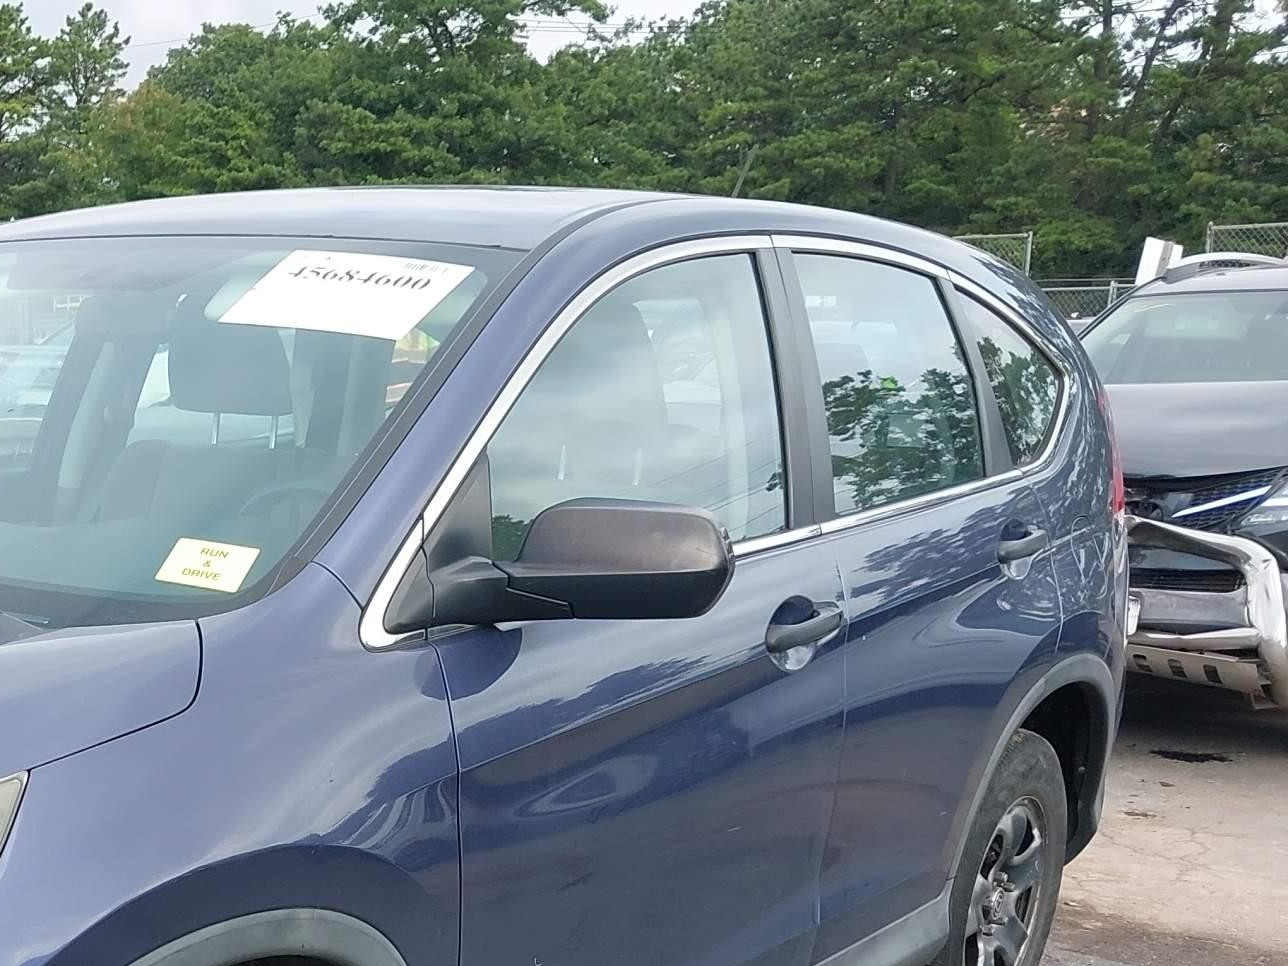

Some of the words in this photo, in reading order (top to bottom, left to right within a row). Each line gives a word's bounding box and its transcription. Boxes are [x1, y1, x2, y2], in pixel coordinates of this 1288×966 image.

[289, 266, 431, 289] 45684600
[200, 548, 229, 558] RUN
[181, 568, 222, 580] DRIVE
